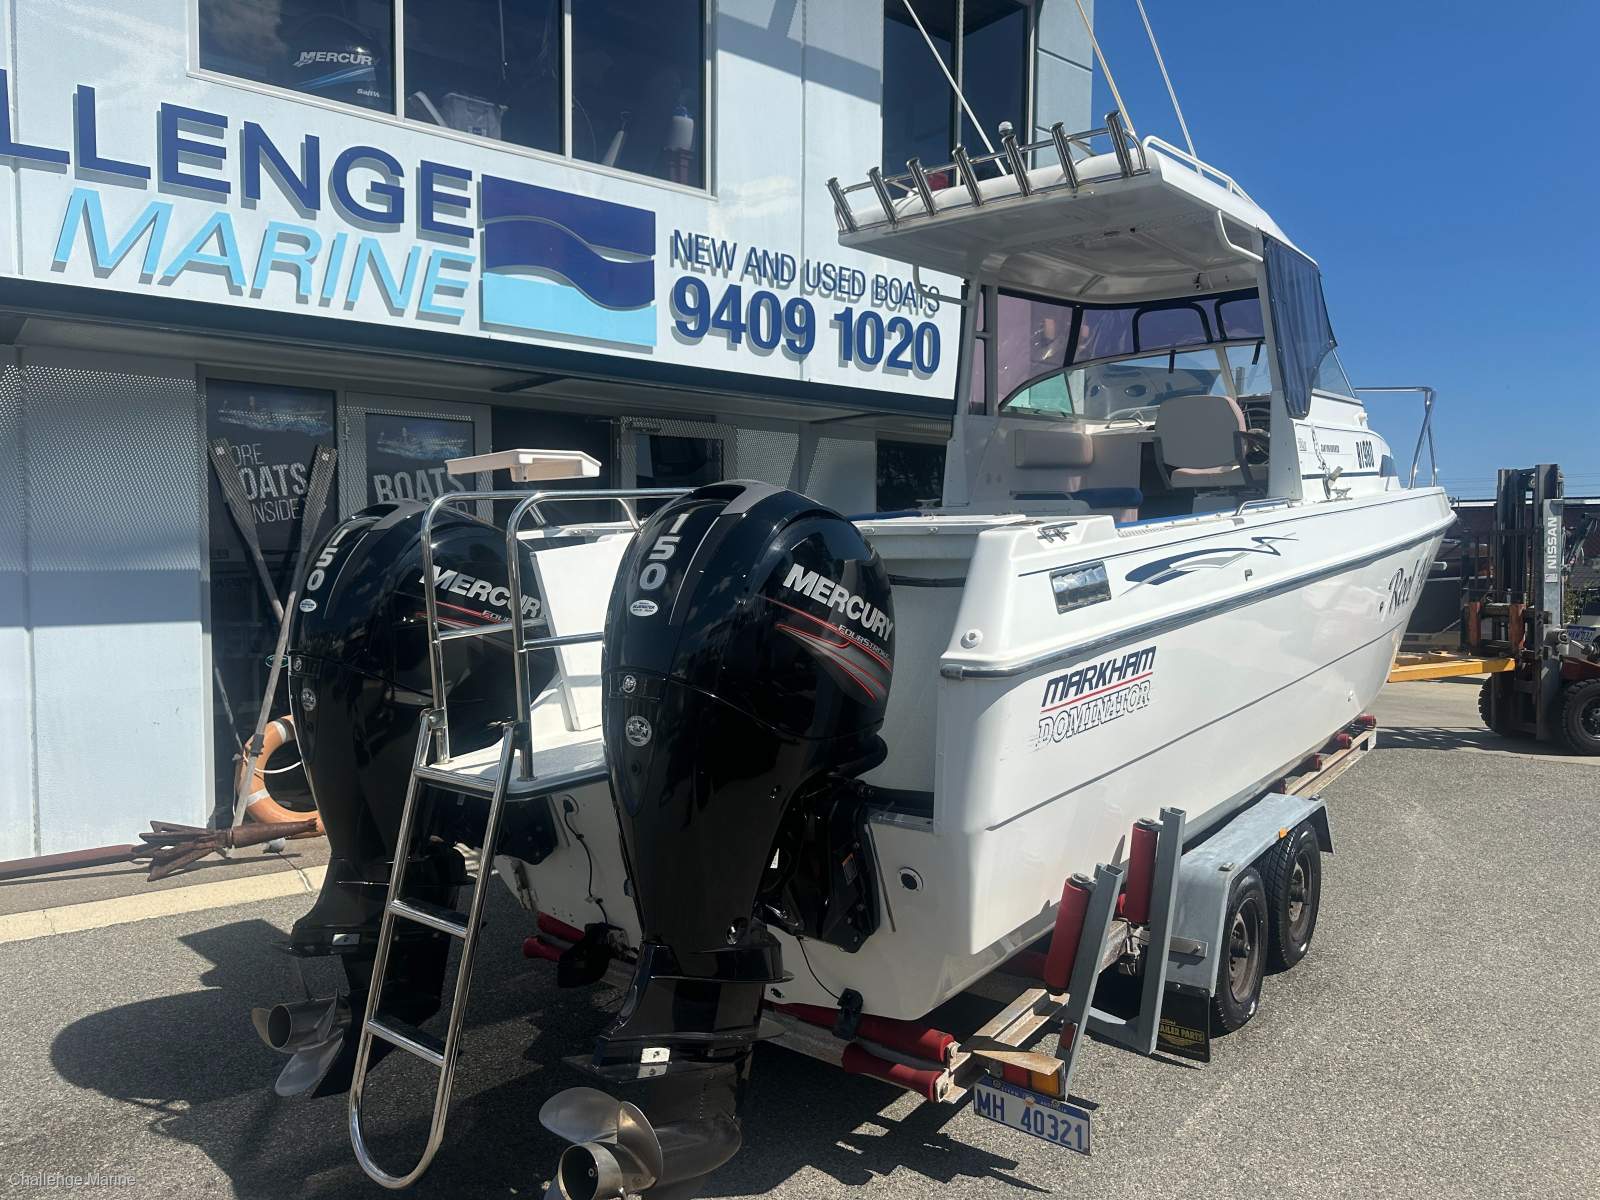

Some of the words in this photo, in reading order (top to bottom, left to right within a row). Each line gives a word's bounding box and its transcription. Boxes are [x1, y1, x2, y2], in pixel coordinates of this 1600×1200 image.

[293, 51, 376, 67] MERCUR
[54, 187, 477, 318] MARINE
[672, 229, 737, 271] NEW
[744, 246, 796, 283] AND
[805, 258, 866, 297] USED
[875, 274, 941, 313] BOATS
[673, 275, 817, 355] 9409
[833, 306, 942, 375] 1020
[231, 443, 264, 467] ORE
[239, 462, 308, 501] OATS
[251, 498, 302, 524] NSIDE
[638, 513, 690, 591] 150
[1547, 516, 1558, 570] NISSAN
[782, 563, 895, 641] MERCURY
[1041, 645, 1157, 708] MARKHAM
[1036, 680, 1151, 744] DOMINATOR
[976, 1089, 1005, 1122] MH
[1020, 1106, 1083, 1150] 40321
